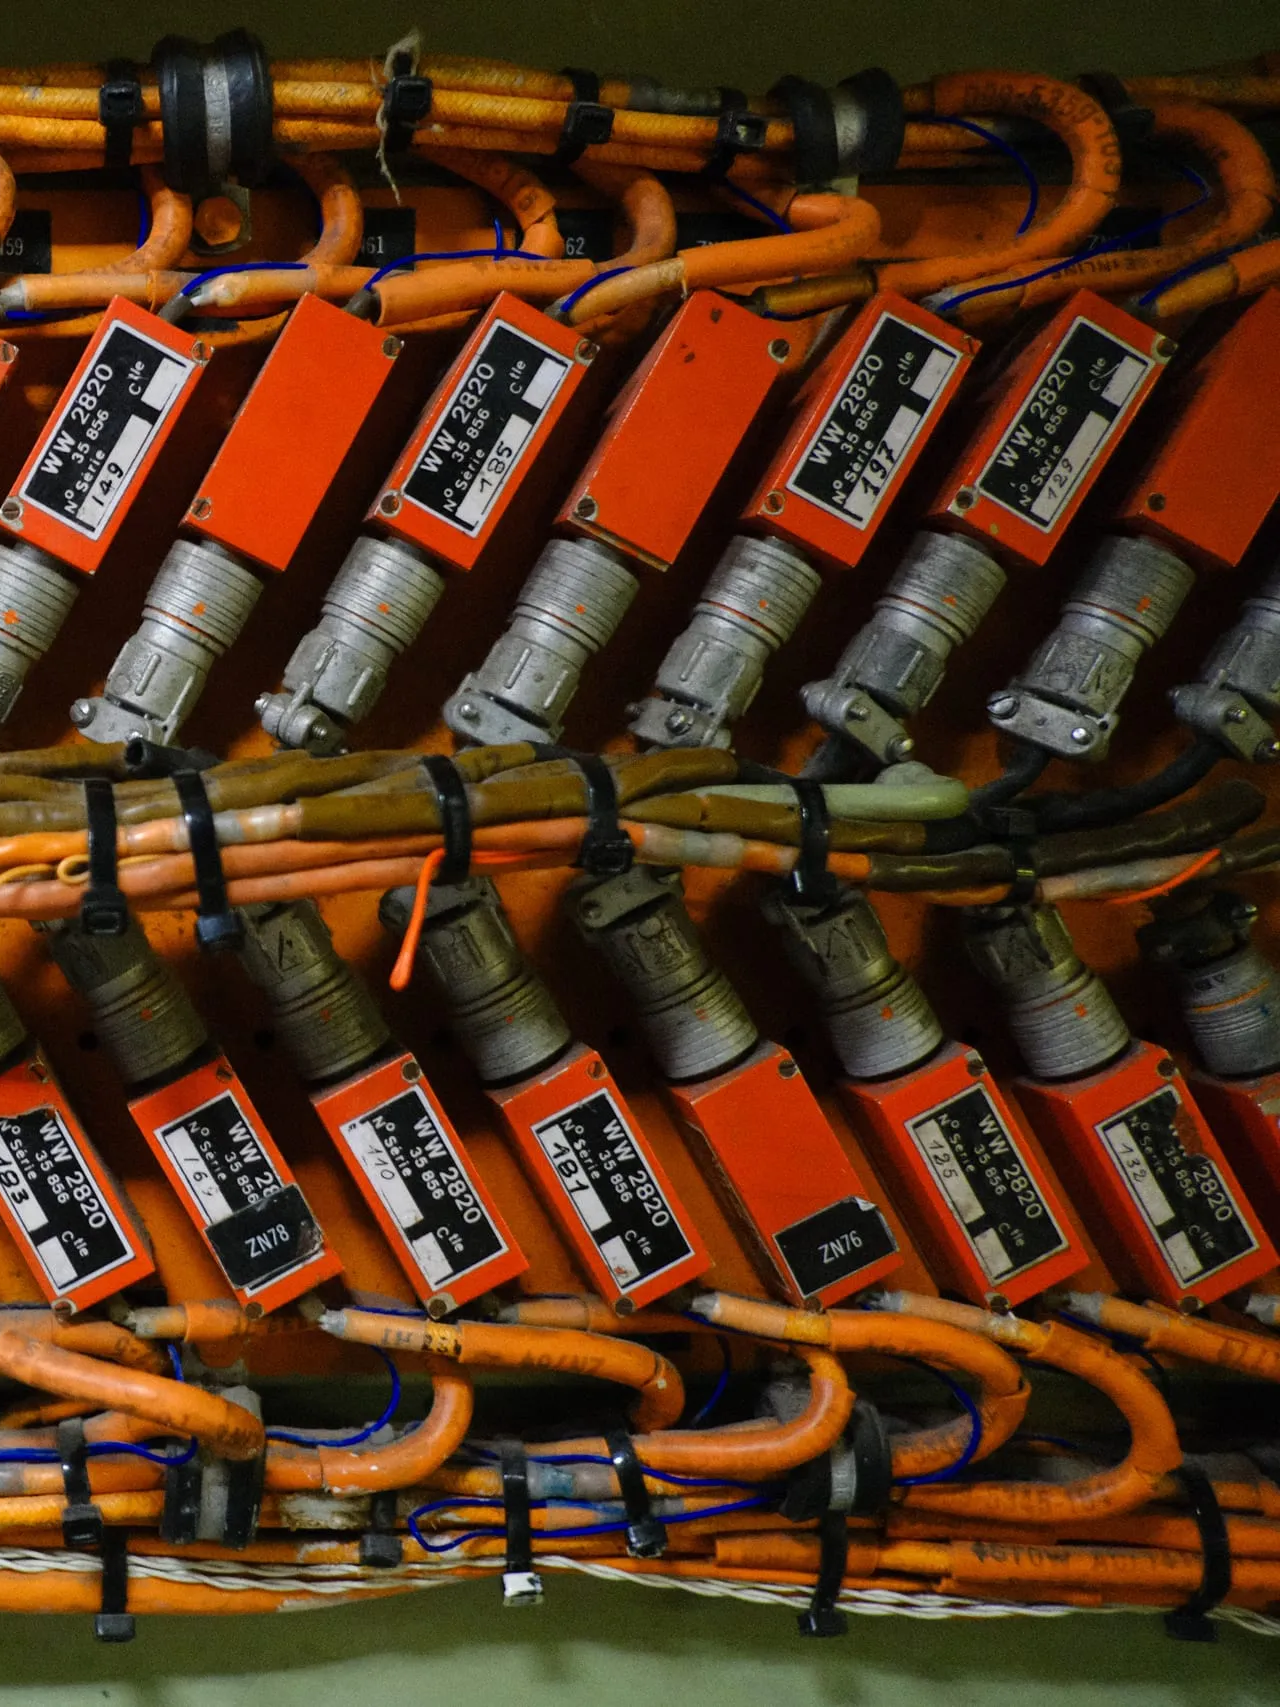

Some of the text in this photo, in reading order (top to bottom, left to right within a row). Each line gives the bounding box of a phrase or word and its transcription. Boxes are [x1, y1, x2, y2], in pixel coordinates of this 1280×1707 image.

[40, 362, 112, 474] WW 2820
[421, 363, 493, 472] WW 2820
[451, 407, 489, 462] 35 856
[809, 353, 882, 464] WW 2820
[840, 399, 878, 454] 35 856
[997, 359, 1073, 466] WW 2820
[1028, 404, 1067, 457] 35 856
[71, 408, 109, 464] 35 856
[91, 462, 123, 506] 149
[479, 440, 512, 492] 185
[861, 440, 901, 505] 197
[227, 1121, 261, 1162] WW
[367, 1144, 395, 1180] 110
[552, 1141, 589, 1191] 181
[929, 1139, 958, 1178] 125
[977, 1113, 1042, 1218] WW 2820
[1119, 1142, 1146, 1182] 132
[35, 1150, 69, 1202] 35 856
[38, 1120, 106, 1227] WW 2820
[224, 1151, 259, 1203] 35 856
[409, 1147, 444, 1198] 35 856
[413, 1116, 480, 1222] WW 2820
[599, 1149, 632, 1201] 35 856
[602, 1119, 668, 1226] WW 2820
[973, 1143, 1006, 1195] 35 856
[1162, 1146, 1181, 1166] 35
[1174, 1168, 1196, 1197] 856
[1191, 1165, 1233, 1220] 2820
[244, 1223, 290, 1260] ZN78
[817, 1228, 863, 1265] ZN76
